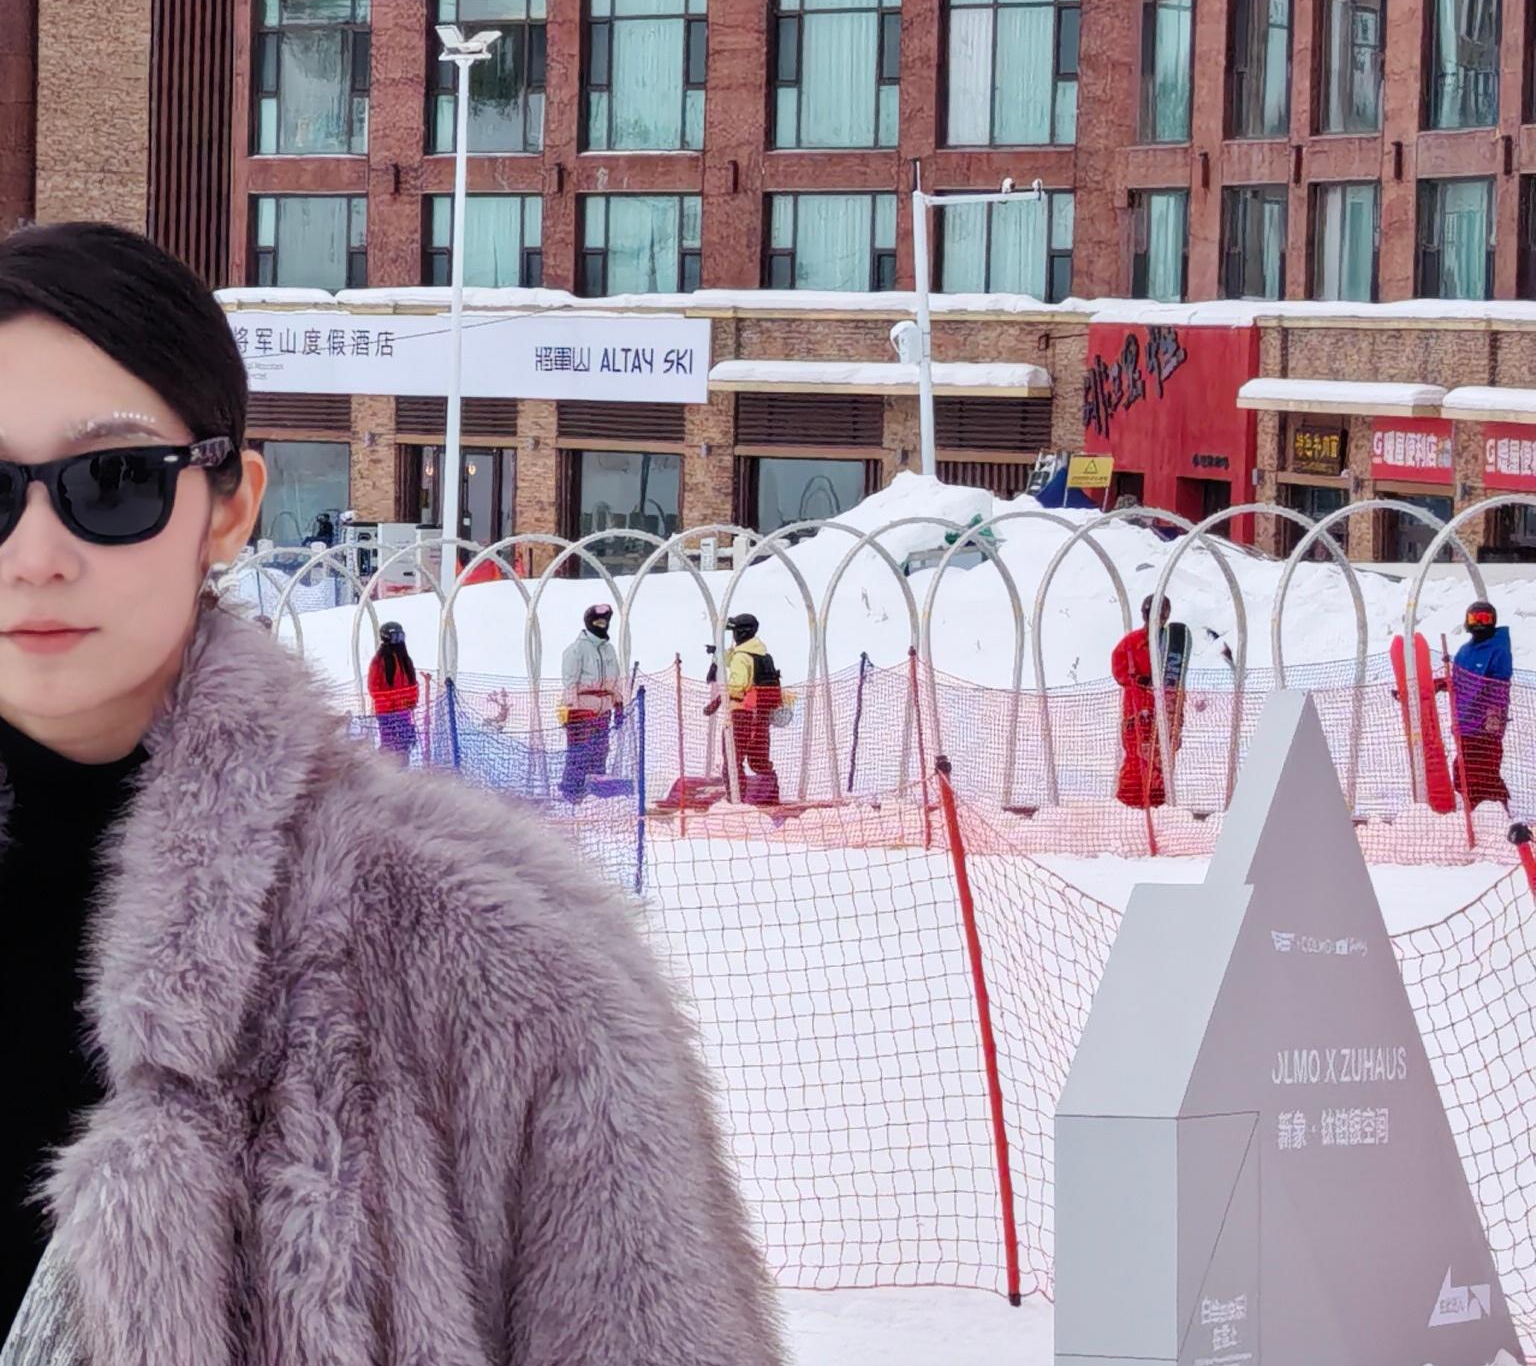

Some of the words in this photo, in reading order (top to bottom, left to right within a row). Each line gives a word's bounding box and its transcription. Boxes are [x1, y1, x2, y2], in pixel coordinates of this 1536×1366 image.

[233, 326, 396, 357] 将军山度假酒店
[600, 347, 654, 373] ALTAY
[663, 348, 694, 375] SKI
[1340, 1046, 1407, 1082] ZUHAUS
